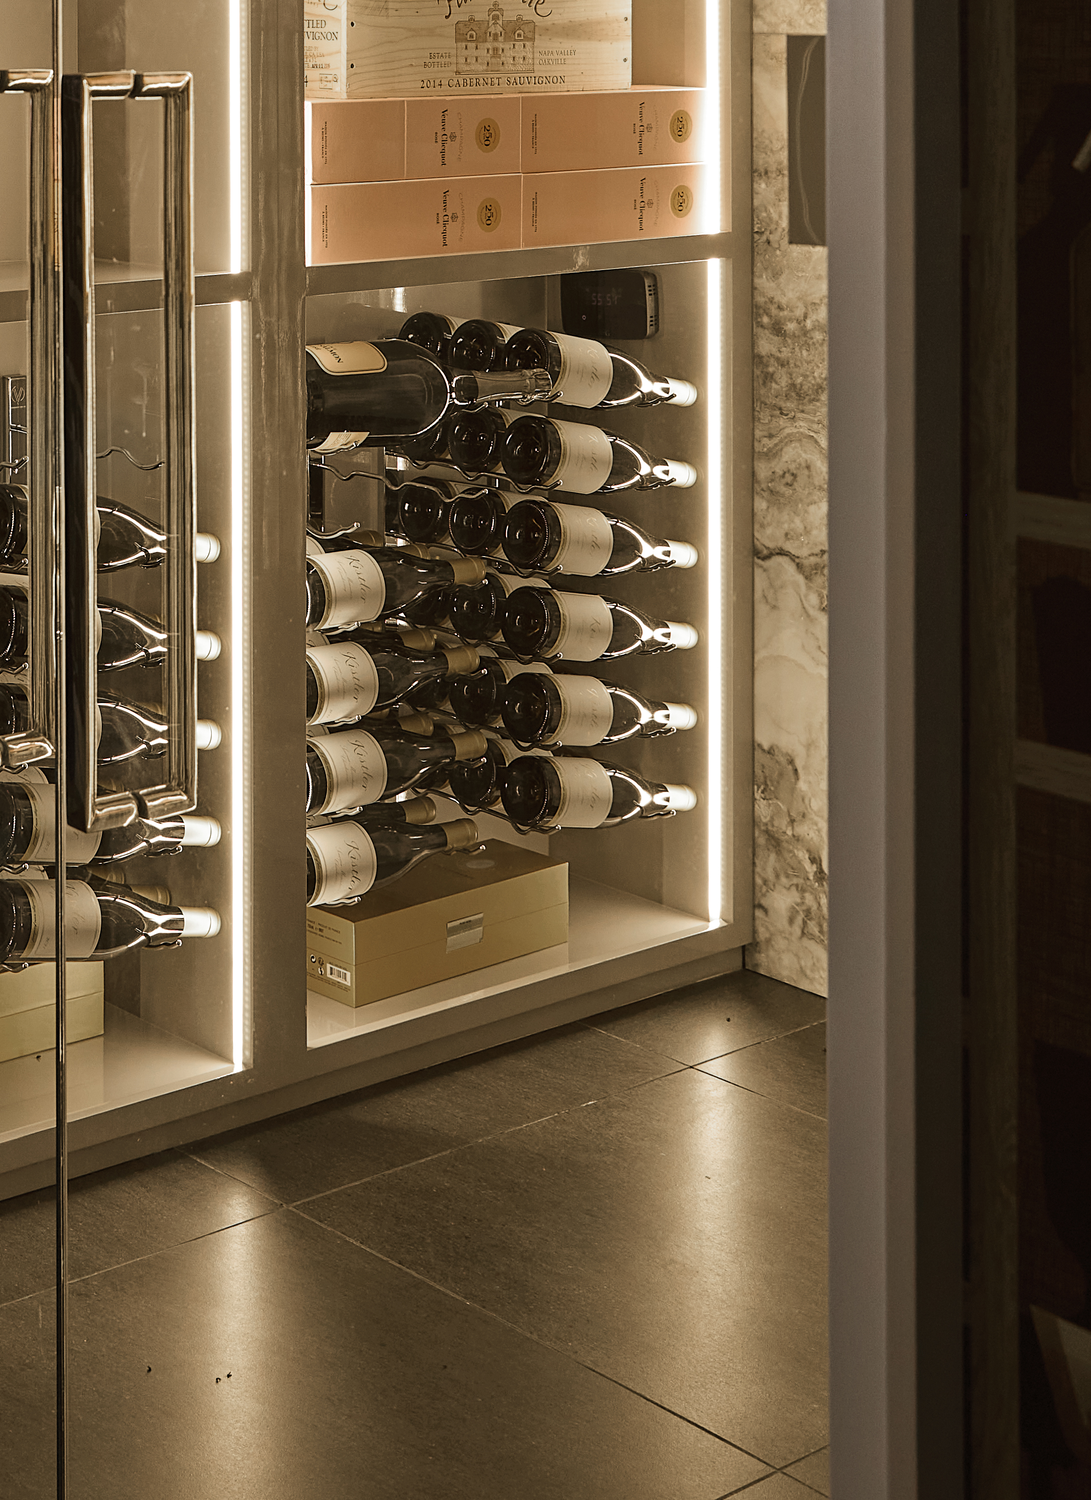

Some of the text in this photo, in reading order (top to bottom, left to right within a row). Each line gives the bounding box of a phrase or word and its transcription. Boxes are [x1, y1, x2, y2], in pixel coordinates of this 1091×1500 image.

[304, 19, 326, 29] TLED
[304, 31, 339, 41] VIGNON
[429, 52, 451, 60] ESTATE
[538, 58, 567, 66] OAKVILLE
[555, 49, 577, 57] VALLEY
[423, 61, 452, 69] BOTTLED
[421, 75, 566, 89] 2014 CABERNET SAUVIGNON
[483, 124, 493, 147] 250
[676, 116, 684, 137] 250
[440, 108, 449, 167] Veuve Clicquot
[677, 191, 685, 212] 250
[441, 189, 450, 247] Veuve Clicquot
[484, 204, 493, 226] 250
[638, 200, 646, 231] Clicquot
[344, 555, 372, 604] Kistler
[341, 651, 366, 703] Kistler
[348, 739, 374, 791] Kistler
[344, 840, 361, 891] Kistler
